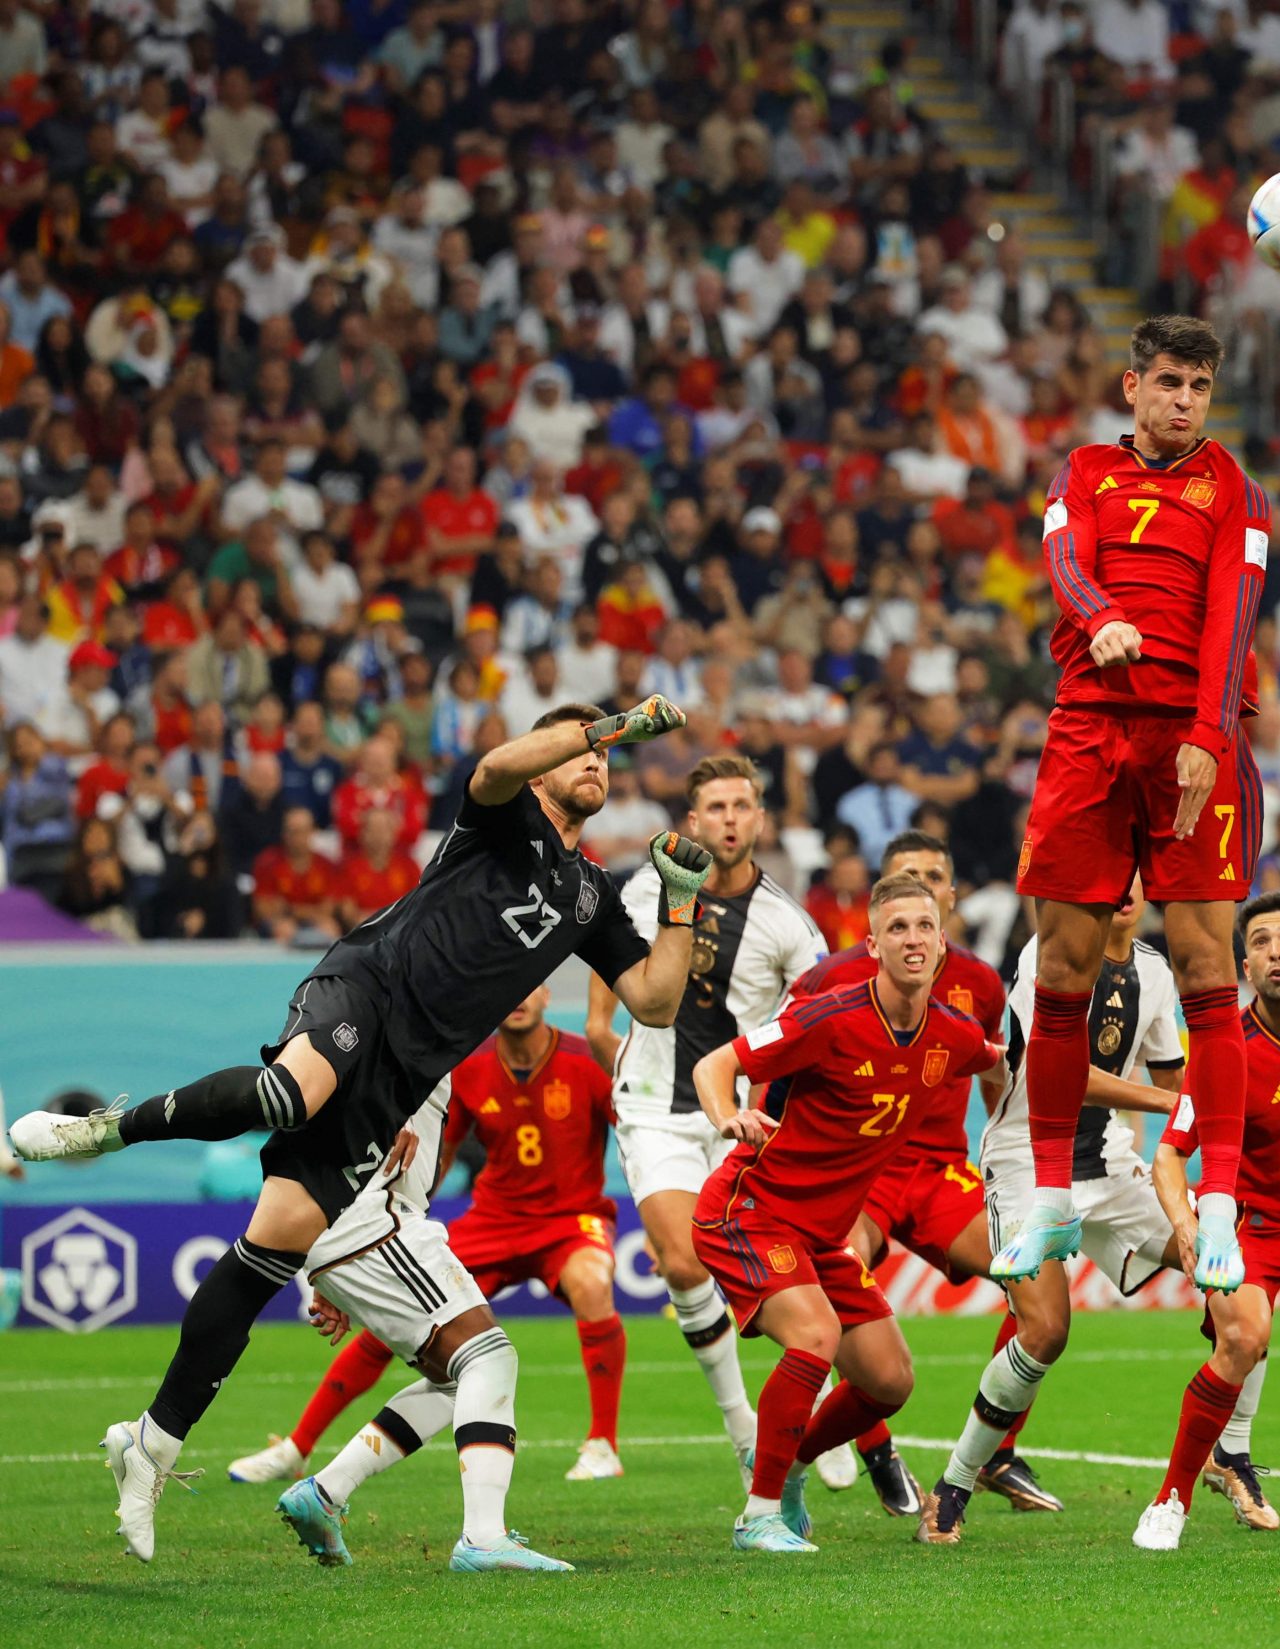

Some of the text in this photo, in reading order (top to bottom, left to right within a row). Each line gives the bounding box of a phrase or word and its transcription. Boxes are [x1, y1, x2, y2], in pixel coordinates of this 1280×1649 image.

[1128, 498, 1160, 544] 7
[1214, 804, 1235, 859] 7
[501, 882, 562, 949] 23
[858, 1093, 911, 1137] 21
[341, 1140, 385, 1193] 2
[515, 1123, 544, 1168] 8
